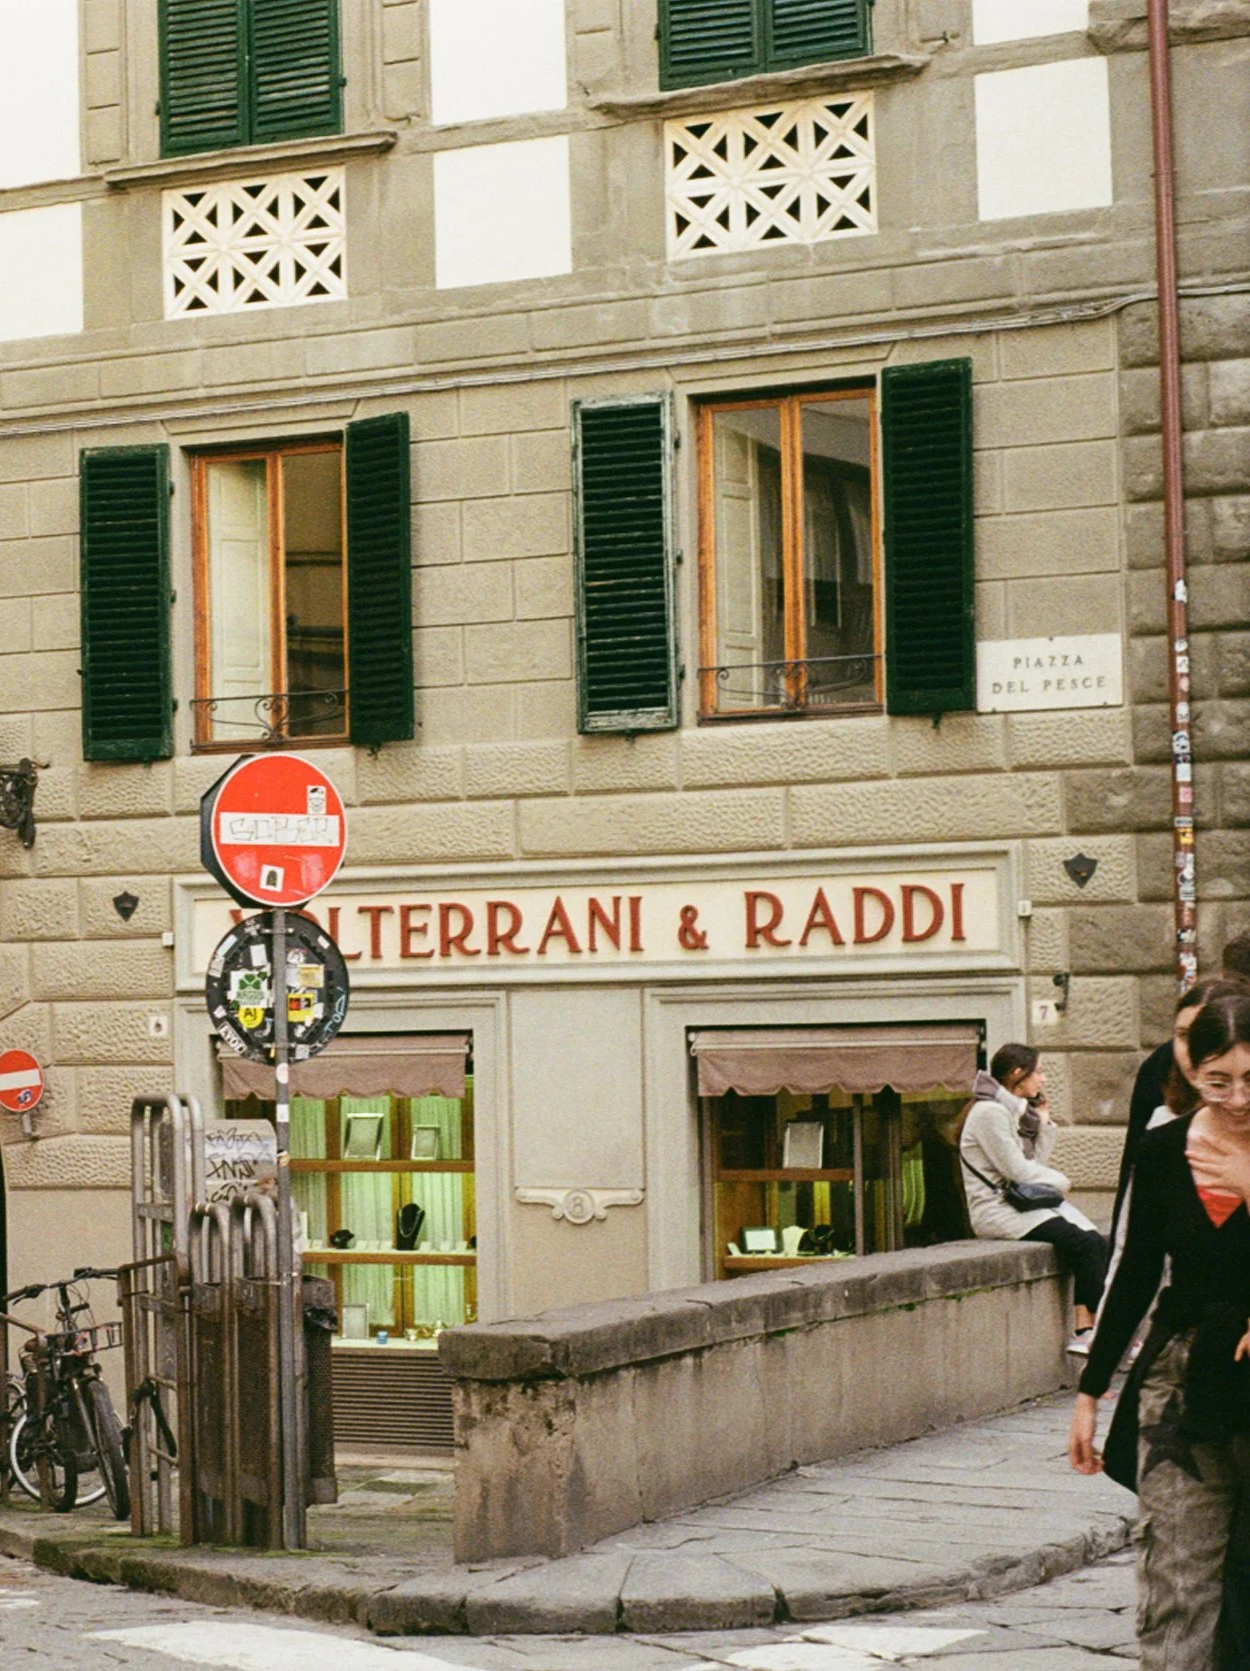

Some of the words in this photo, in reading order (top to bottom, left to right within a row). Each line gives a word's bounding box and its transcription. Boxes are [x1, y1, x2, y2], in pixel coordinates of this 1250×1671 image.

[1013, 655, 1084, 669] PIAZZA
[992, 681, 1029, 694] DEL
[1043, 676, 1106, 691] PESCE
[228, 895, 643, 960] LTERRANI
[678, 904, 708, 950] &
[744, 883, 967, 949] RADDI
[1038, 1005, 1049, 1020] 7
